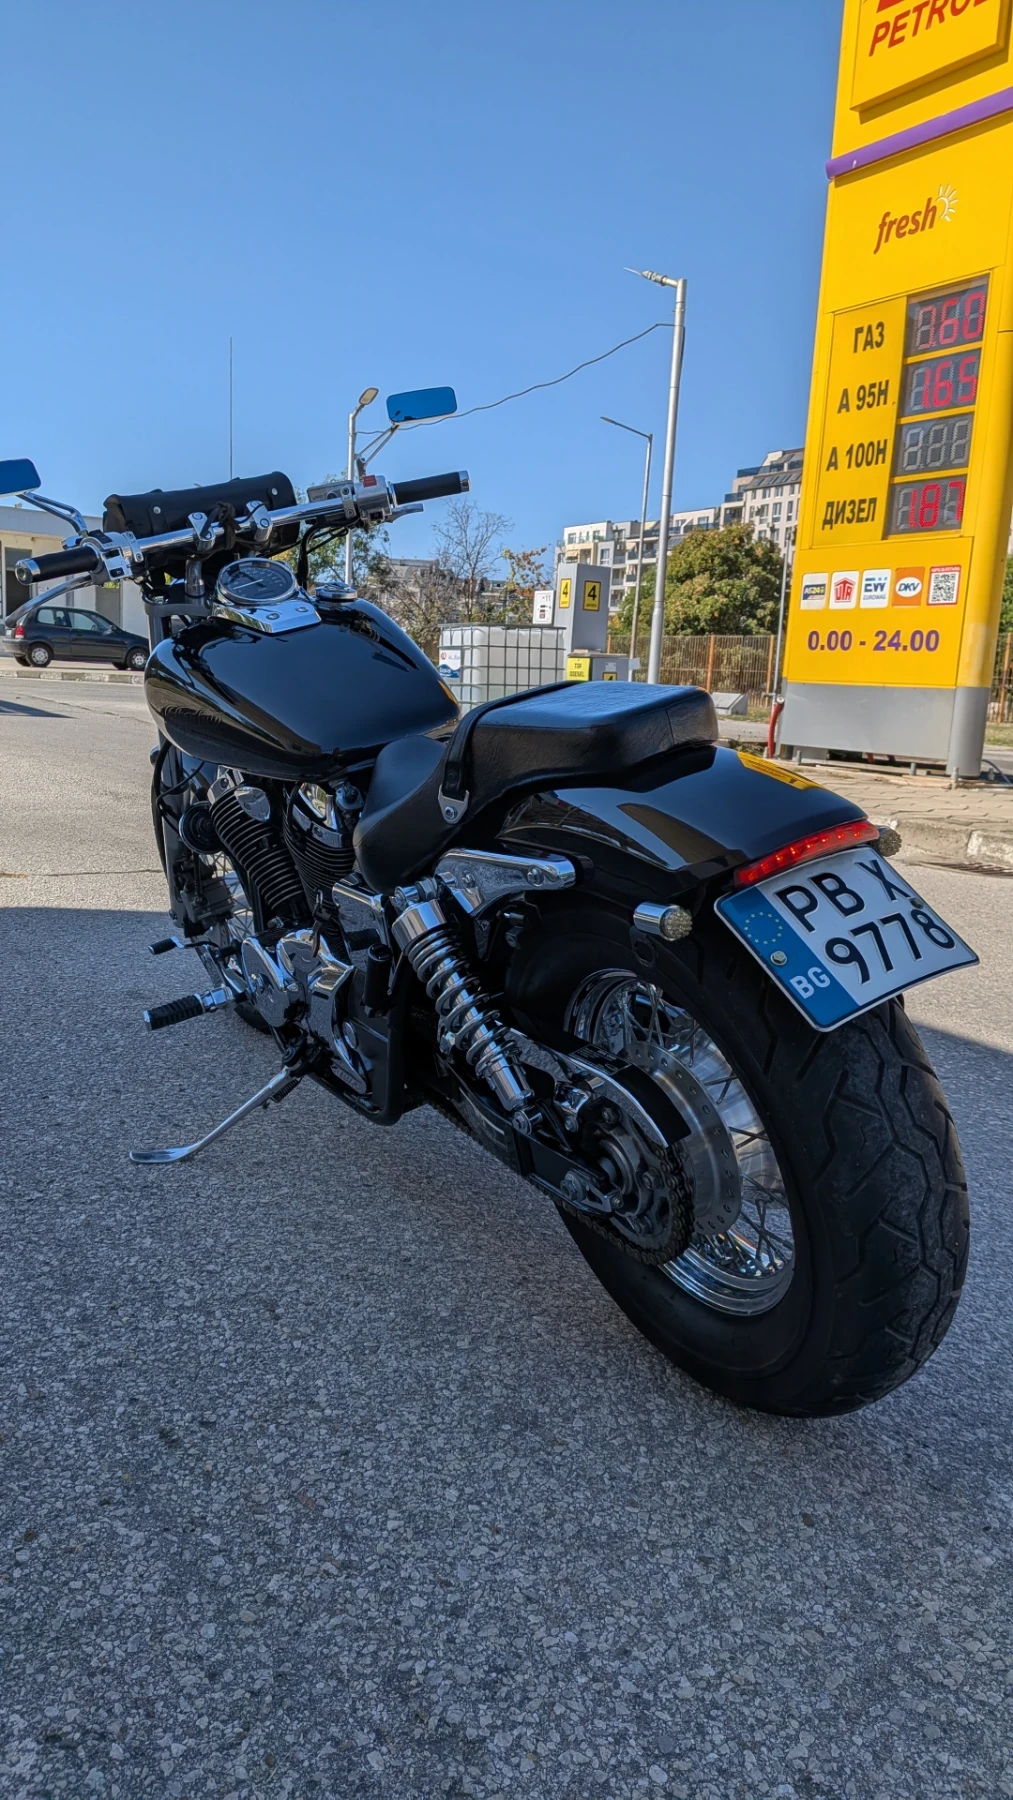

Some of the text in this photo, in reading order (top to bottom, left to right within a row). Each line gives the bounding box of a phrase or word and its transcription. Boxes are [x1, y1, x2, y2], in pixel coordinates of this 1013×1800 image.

[868, 0, 989, 57] PETRO
[873, 197, 937, 254] fresh
[853, 321, 885, 353] ГАЗ
[837, 379, 889, 414] А 95Н
[825, 439, 888, 472] А 100Н
[821, 497, 877, 531] ДИЗЕЛ
[562, 582, 569, 598] 4
[587, 585, 597, 601] 4
[898, 582, 920, 592] DKV
[807, 630, 853, 651] 0.00
[872, 629, 940, 652] 24.00
[774, 859, 912, 933] PB X
[824, 909, 956, 984] 9778
[789, 967, 831, 1000] BG
